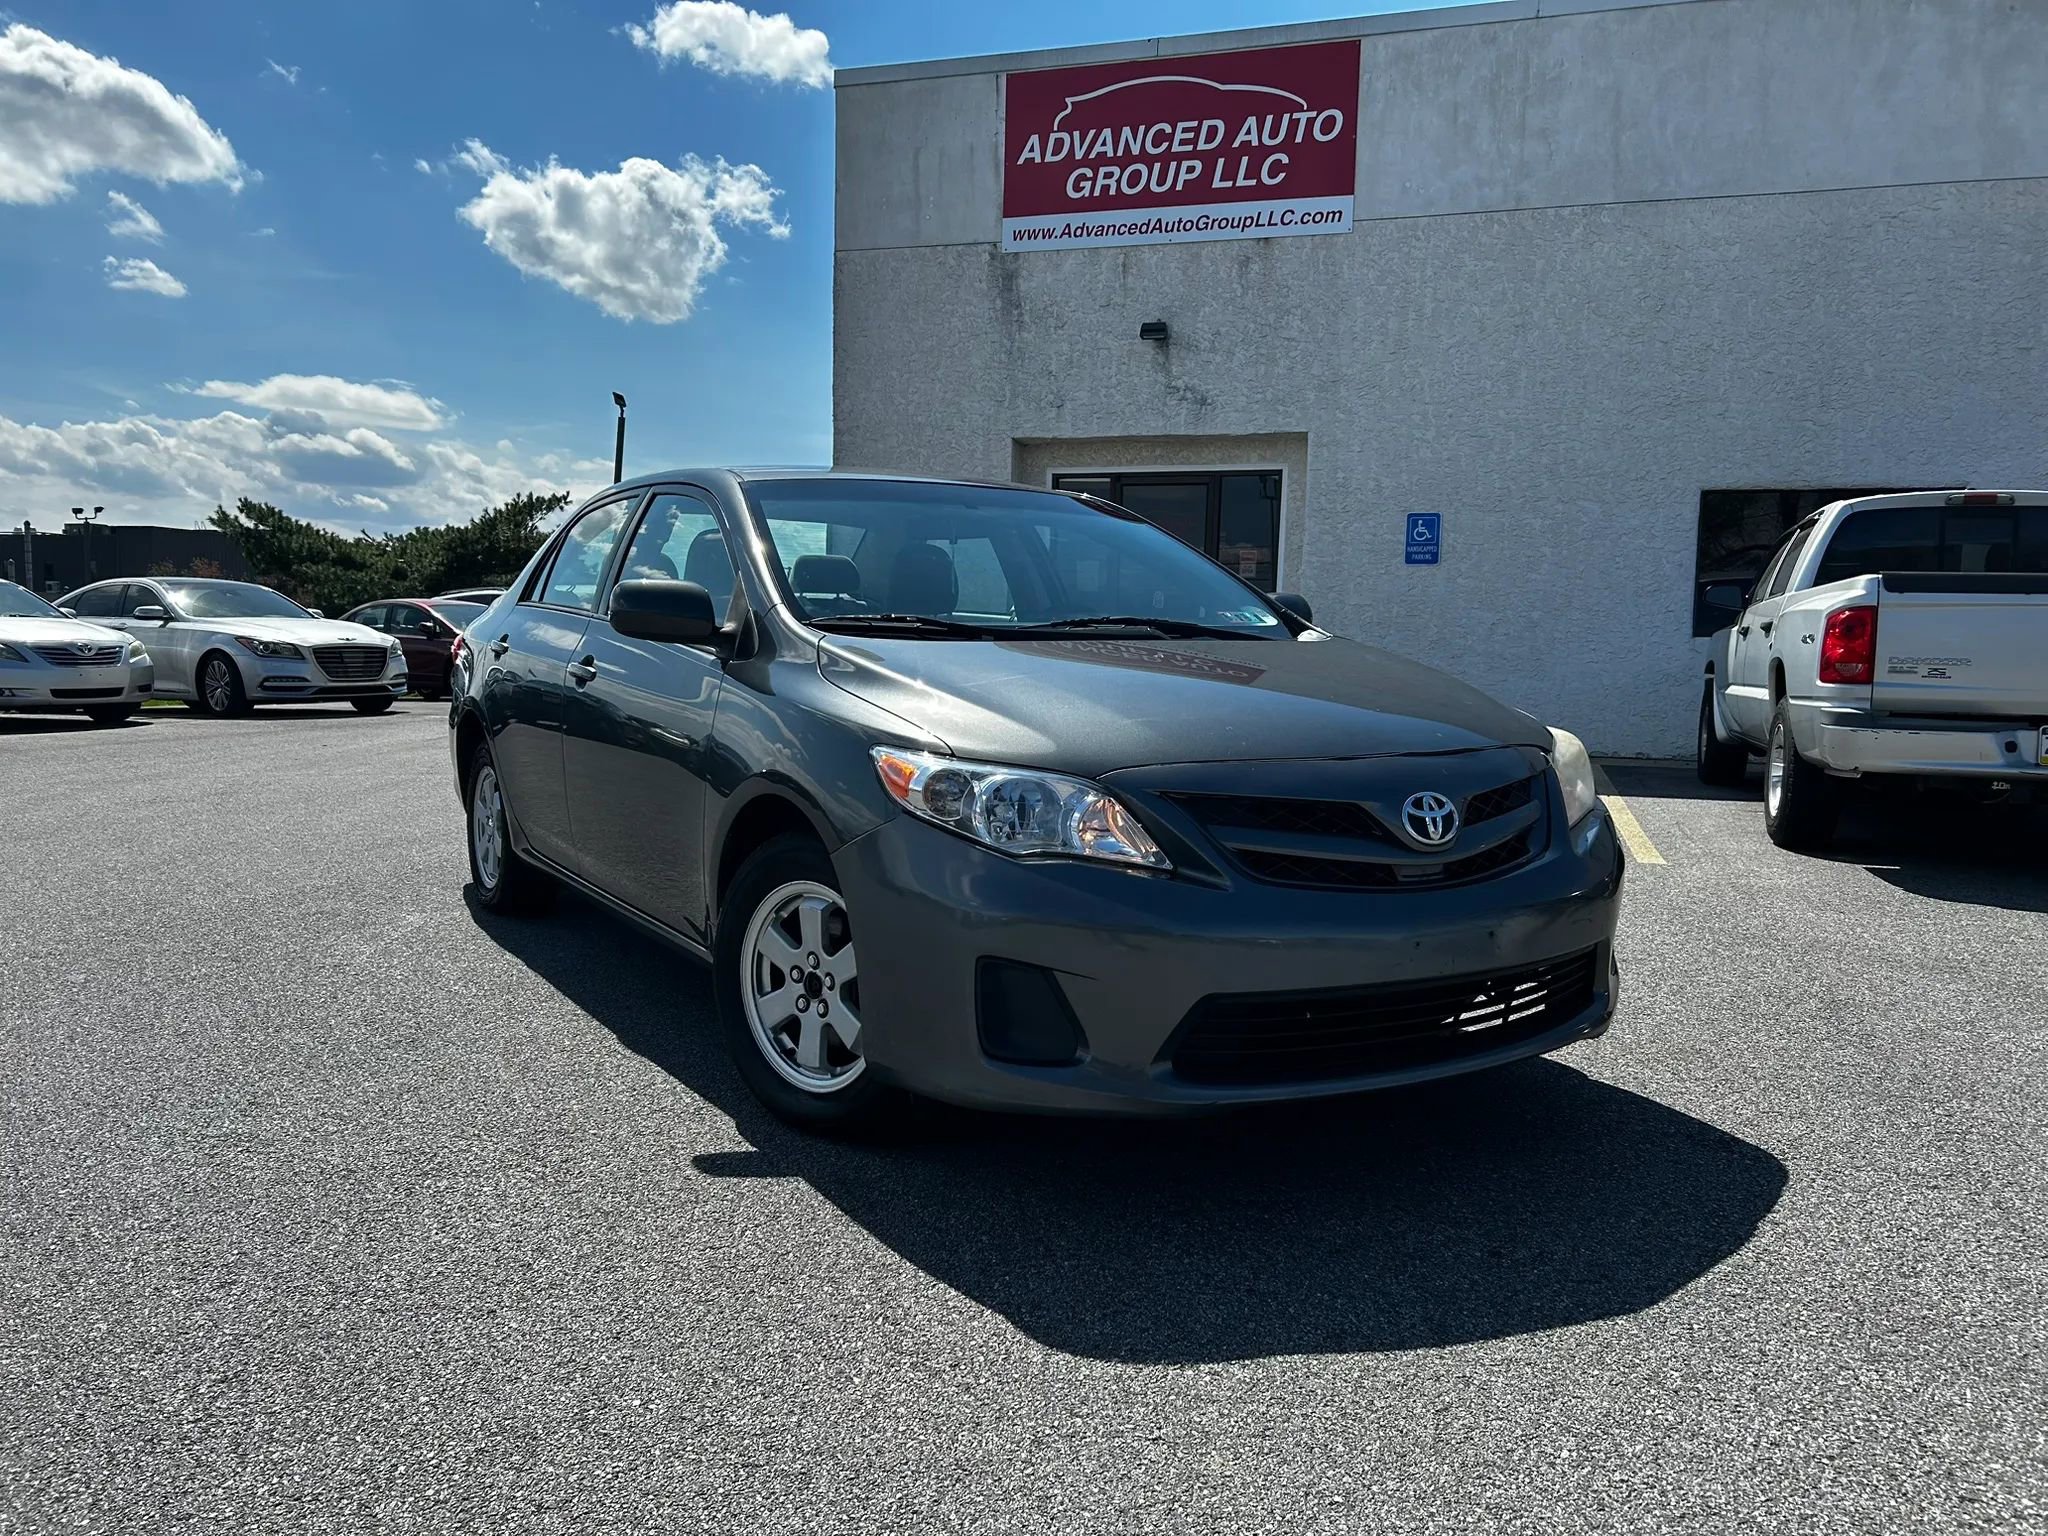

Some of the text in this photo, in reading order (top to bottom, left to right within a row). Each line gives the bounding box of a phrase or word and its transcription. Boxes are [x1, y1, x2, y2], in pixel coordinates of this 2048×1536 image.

[1017, 108, 1343, 165] ADVANCED AUTO
[1065, 153, 1290, 199] GROUP LLC
[1012, 208, 1344, 242] www.AdvancedAutoGroupLLC.com
[1406, 545, 1438, 553] HANDICAPPED
